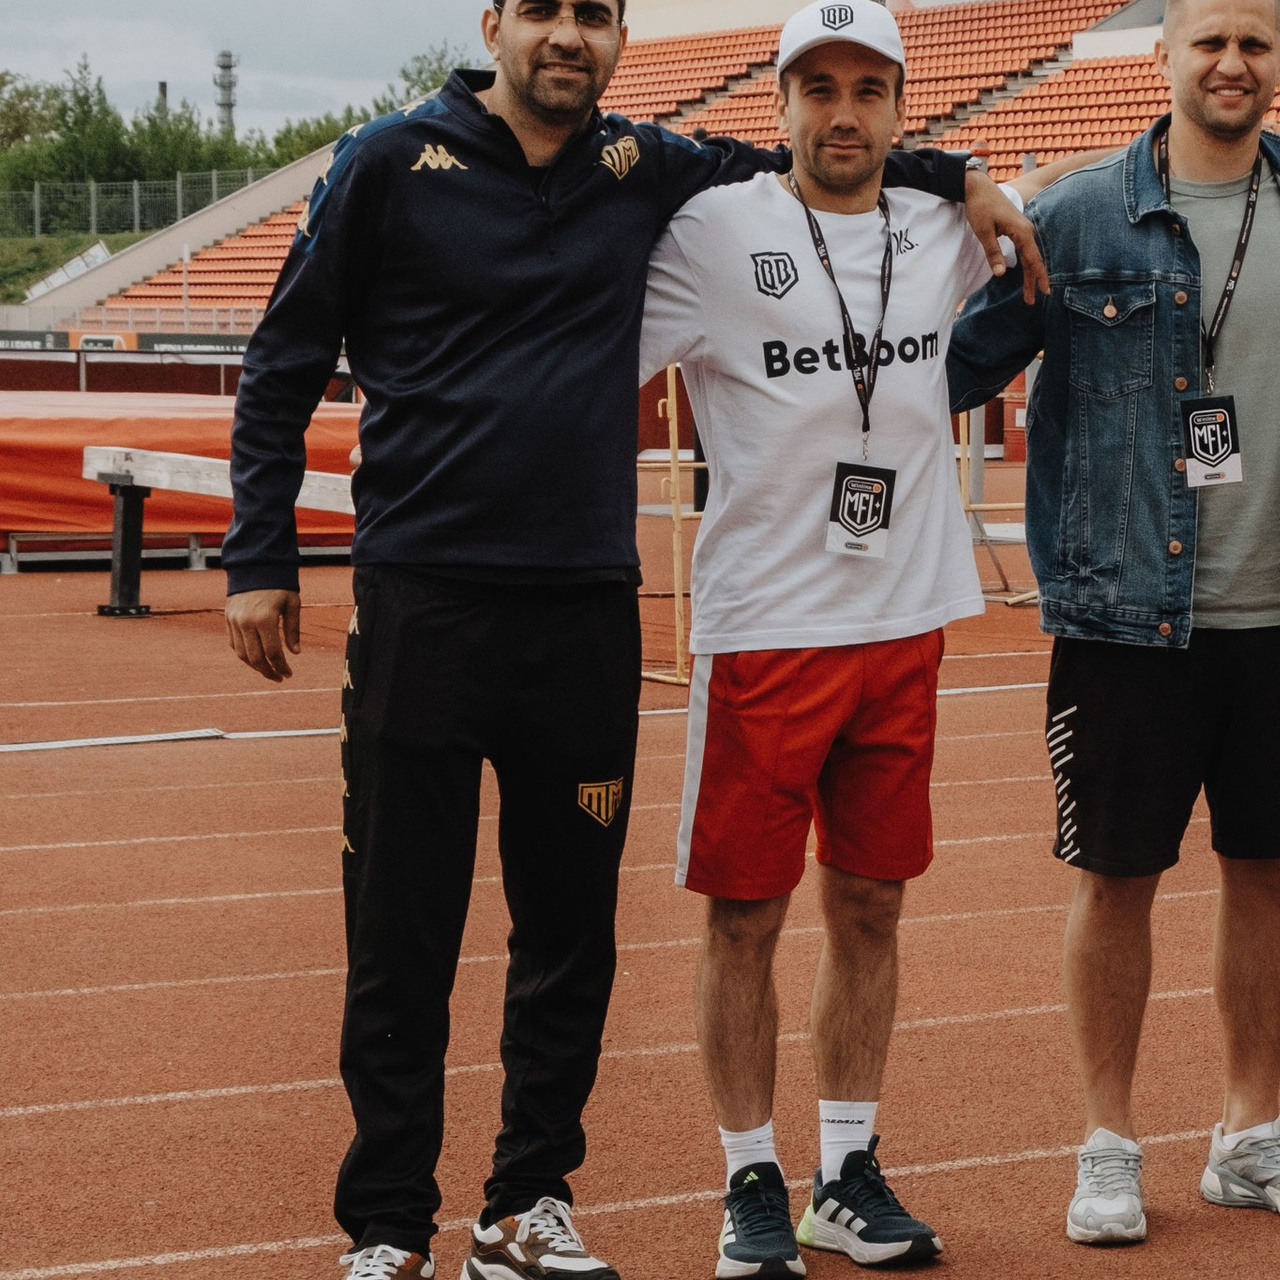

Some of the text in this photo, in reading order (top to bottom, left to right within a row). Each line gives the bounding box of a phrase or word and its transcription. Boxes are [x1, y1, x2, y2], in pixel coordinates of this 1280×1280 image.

[763, 330, 938, 378] BetBoom
[1194, 424, 1228, 461] MFL
[843, 491, 878, 529] MFL
